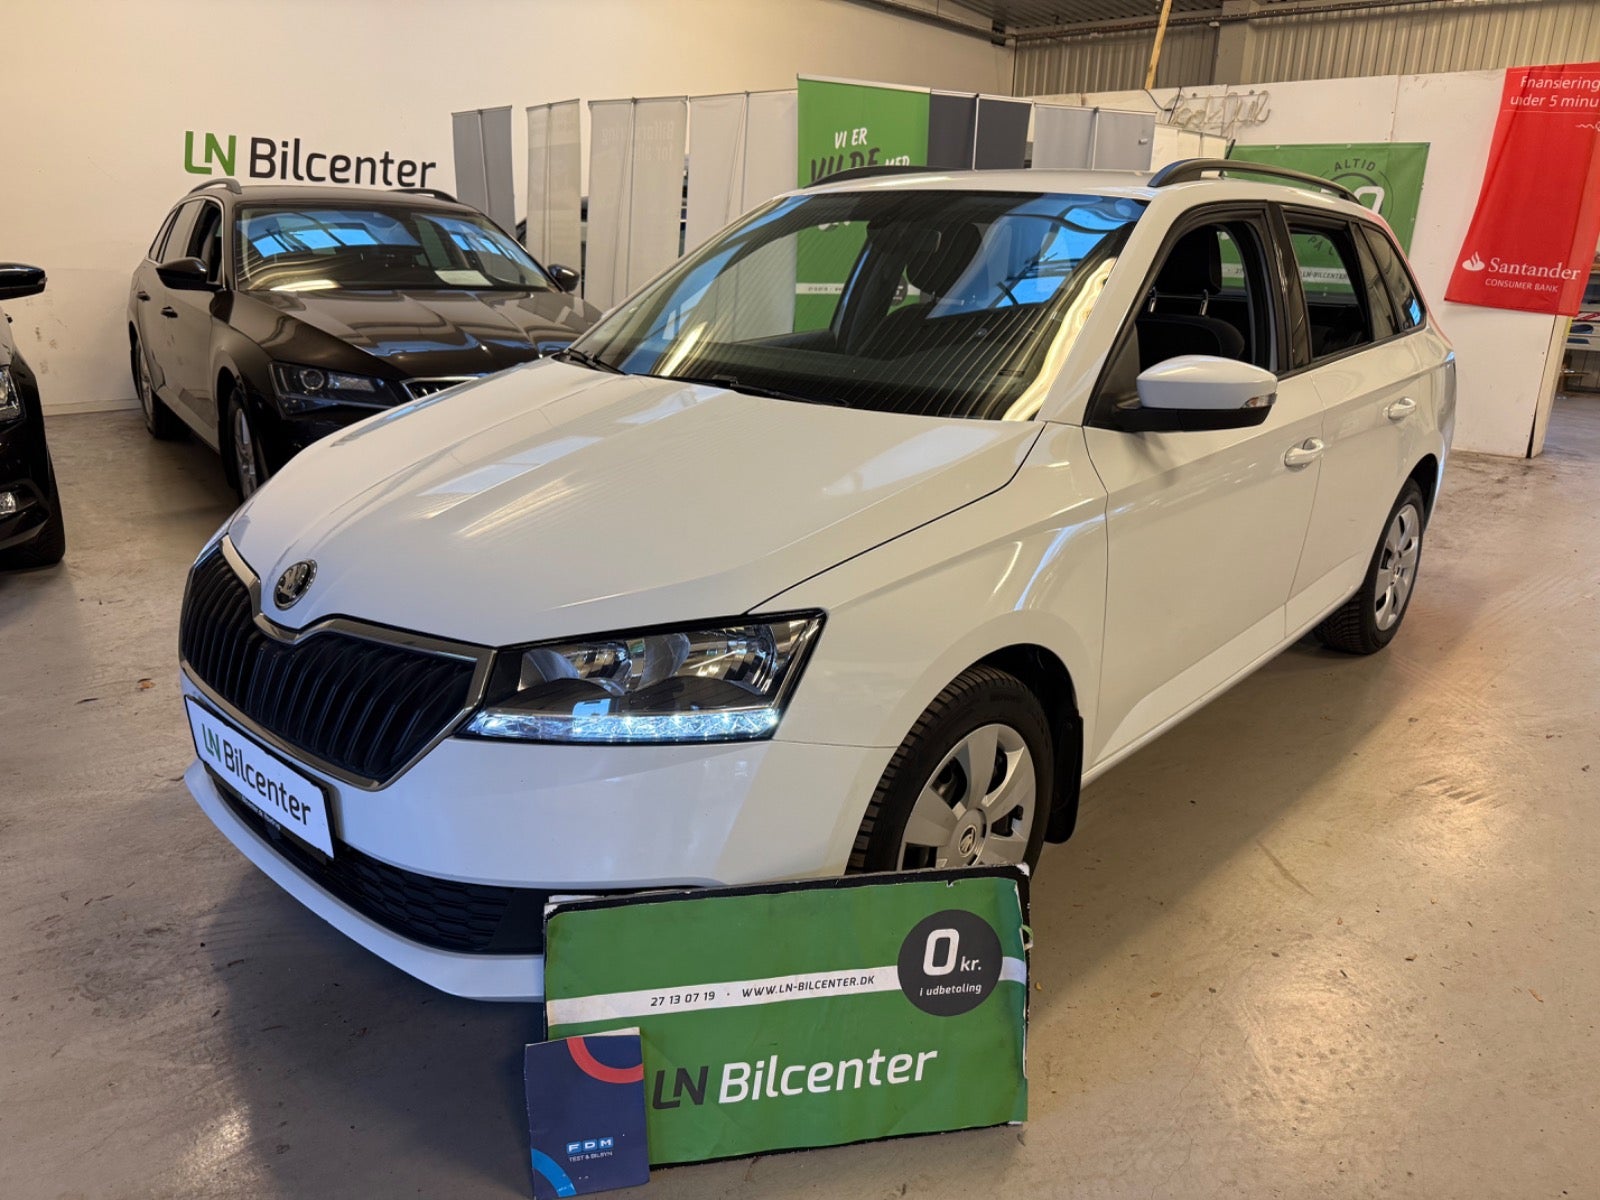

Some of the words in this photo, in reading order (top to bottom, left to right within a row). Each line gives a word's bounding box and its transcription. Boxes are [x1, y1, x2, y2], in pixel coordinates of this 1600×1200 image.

[1549, 95, 1558, 107] 5
[835, 130, 847, 149] VI
[851, 127, 868, 146] ER
[184, 130, 237, 177] LN
[249, 136, 436, 188] Bilcenter
[1334, 158, 1376, 172] ALTID
[1488, 257, 1581, 280] Santander
[1485, 278, 1532, 290] CONSUMER
[1534, 284, 1558, 293] BANK
[202, 723, 222, 762] LN
[223, 739, 311, 825] Bilcenter
[923, 928, 960, 976] 0
[960, 956, 982, 972] kr.
[650, 996, 665, 1007] 27
[669, 994, 681, 1005] 13
[684, 992, 699, 1003] 07
[704, 991, 716, 1001] 19
[742, 975, 875, 998] WWW.LN-BILCENTER.DK
[926, 983, 982, 996] udbetaling
[652, 1066, 709, 1109] LN
[718, 1049, 938, 1104] Bilcenter
[568, 1139, 612, 1152] FDM
